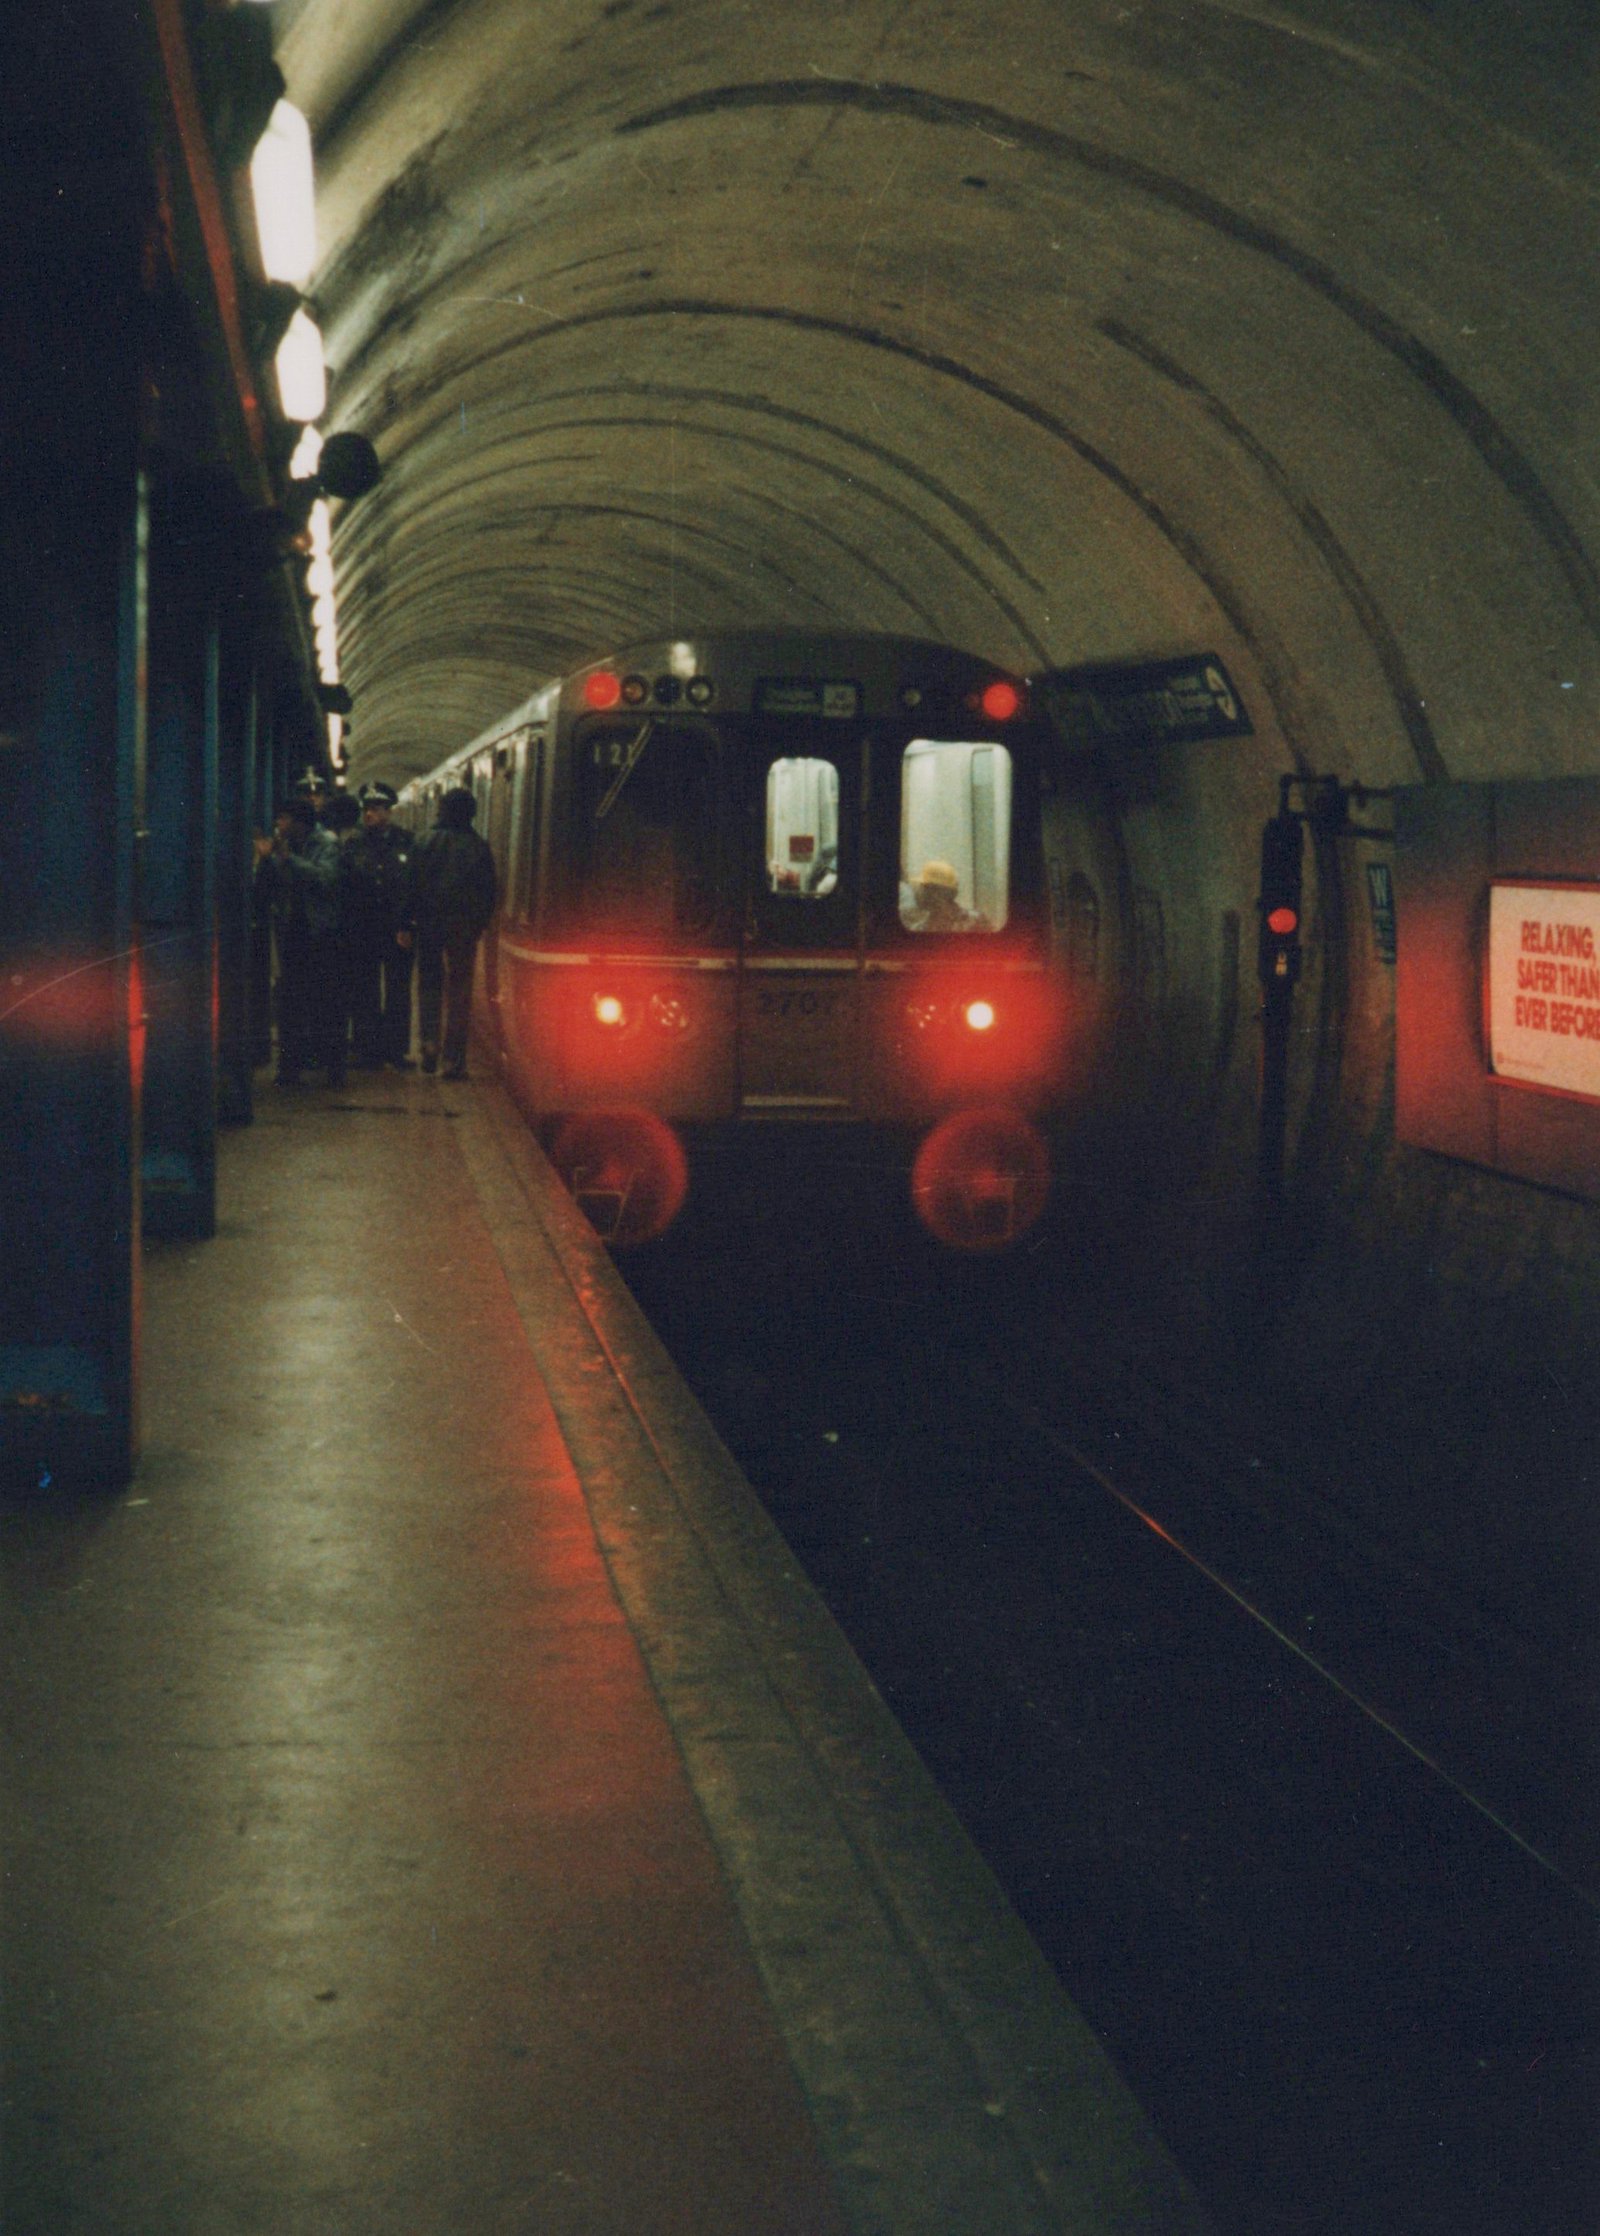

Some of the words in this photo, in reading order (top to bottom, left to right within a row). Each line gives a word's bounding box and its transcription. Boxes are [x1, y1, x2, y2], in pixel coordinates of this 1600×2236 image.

[1521, 920, 1596, 963] RELAXING,
[1517, 957, 1556, 994] SAFER
[1559, 964, 1600, 1001] THAN
[1514, 996, 1548, 1032] EVER
